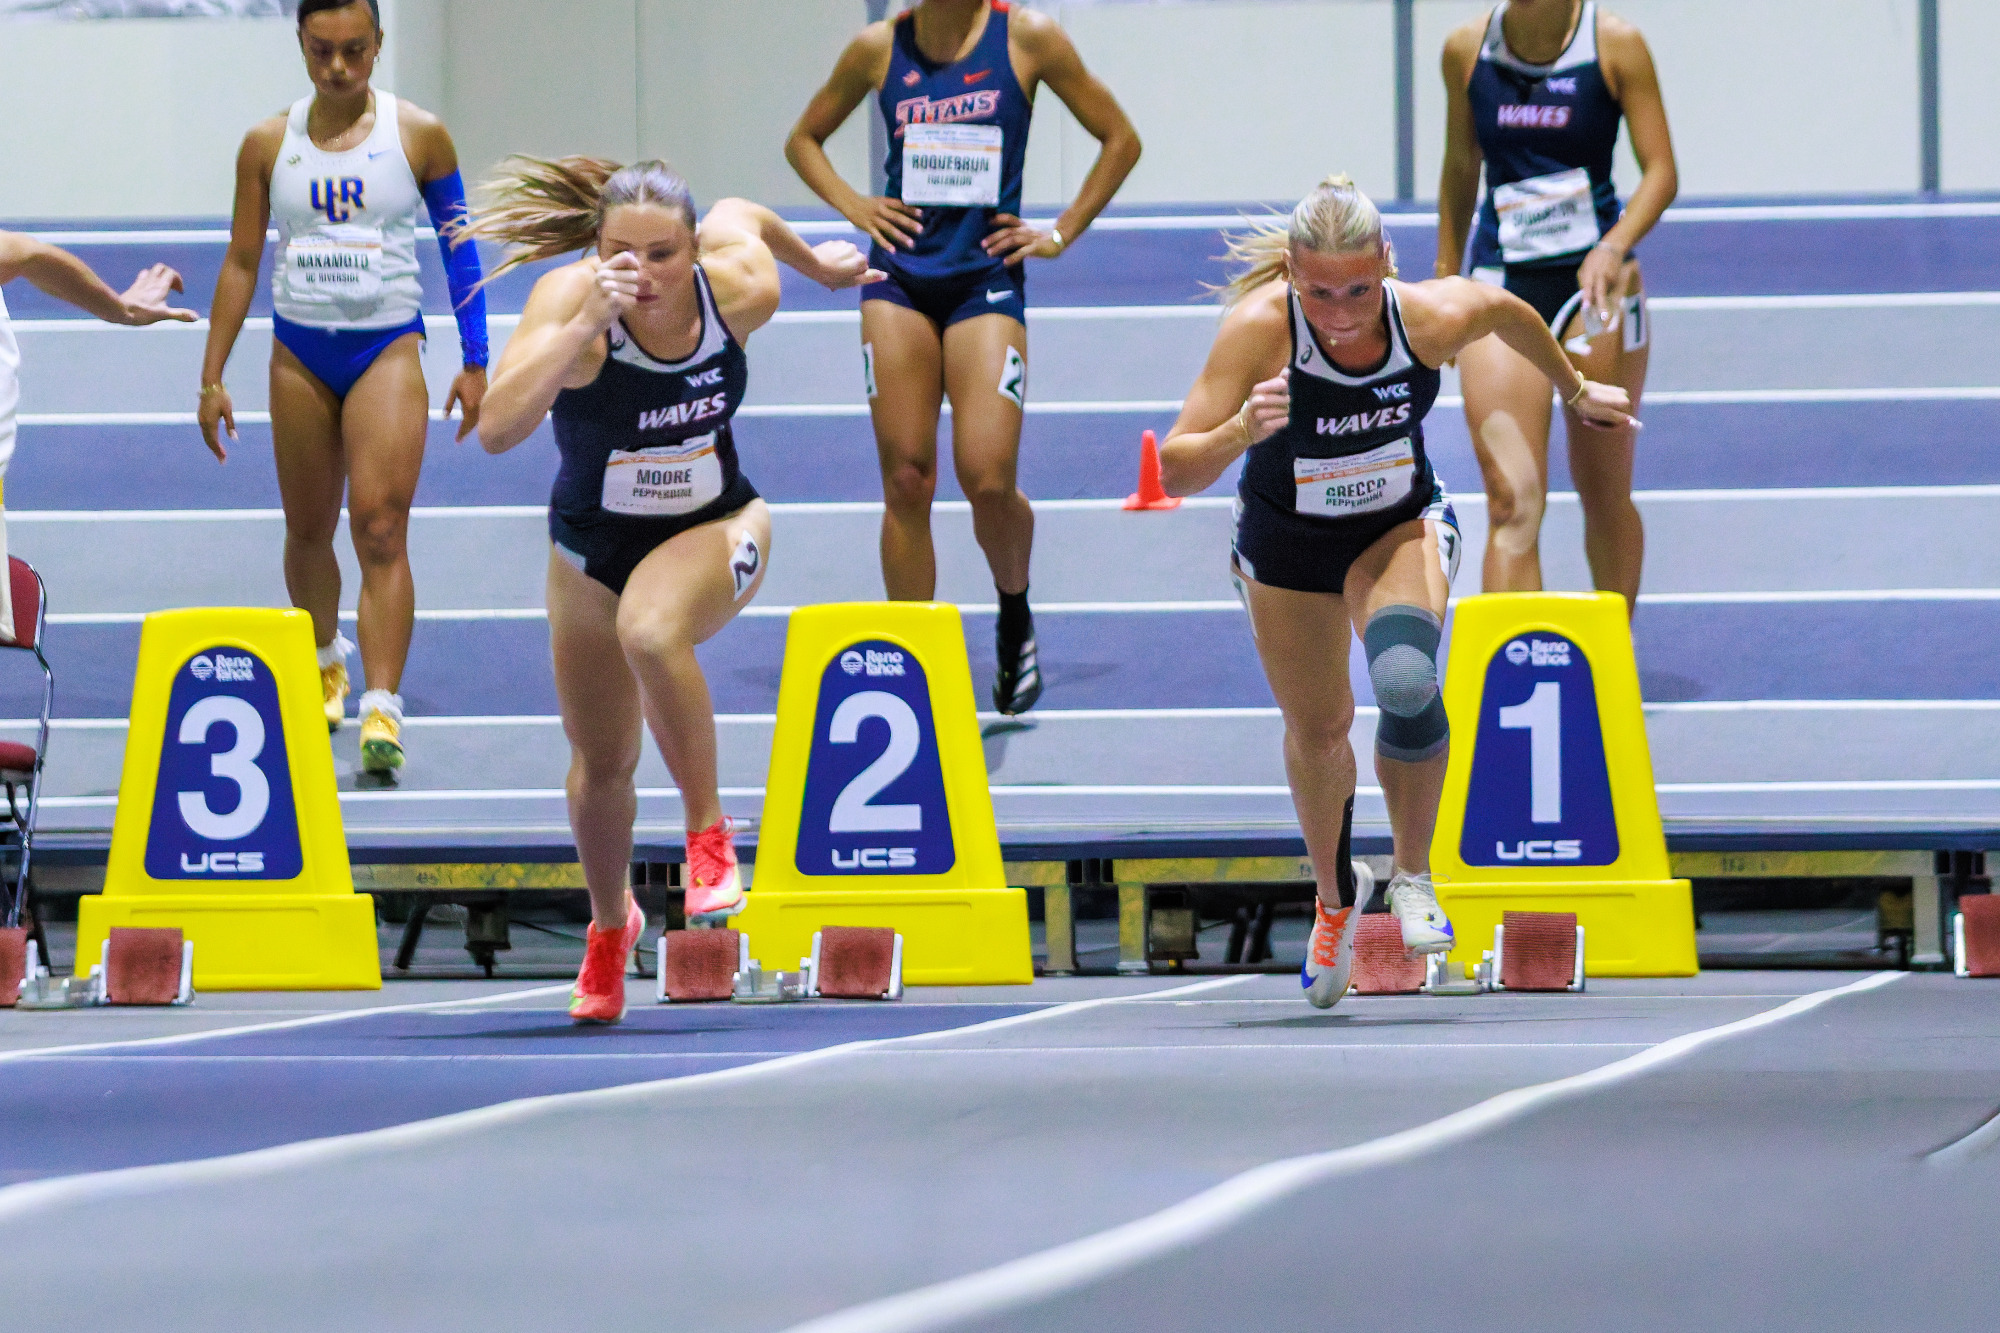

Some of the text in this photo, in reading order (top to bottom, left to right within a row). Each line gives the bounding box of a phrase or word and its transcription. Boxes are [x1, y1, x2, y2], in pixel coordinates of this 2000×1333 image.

[896, 90, 1000, 125] TITANS
[1497, 104, 1572, 128] WAVES
[912, 154, 990, 172] ROQUEBRUN
[310, 176, 366, 223] UCR
[297, 252, 370, 270] NAKAMOTO
[305, 272, 316, 283] UC
[1629, 302, 1641, 343] 1
[684, 367, 724, 388] WCC
[1005, 355, 1022, 400] 2
[1371, 382, 1412, 401] WCC
[637, 391, 727, 430] WAVES
[1316, 402, 1411, 435] WAVES
[637, 468, 692, 485] MOORE
[633, 487, 692, 500] PEPPERDINE
[1326, 477, 1387, 497] GRECCO
[1325, 491, 1383, 508] PEPPERDINE
[733, 541, 759, 590] 2
[866, 649, 904, 663] Reno
[1532, 639, 1570, 653] Reno
[216, 654, 253, 668] Reno
[829, 690, 922, 833] 2
[1499, 682, 1561, 823] 1
[177, 695, 270, 840] 3
[831, 848, 917, 868] UCS
[1496, 840, 1581, 860] UCS
[180, 852, 265, 873] UCS
